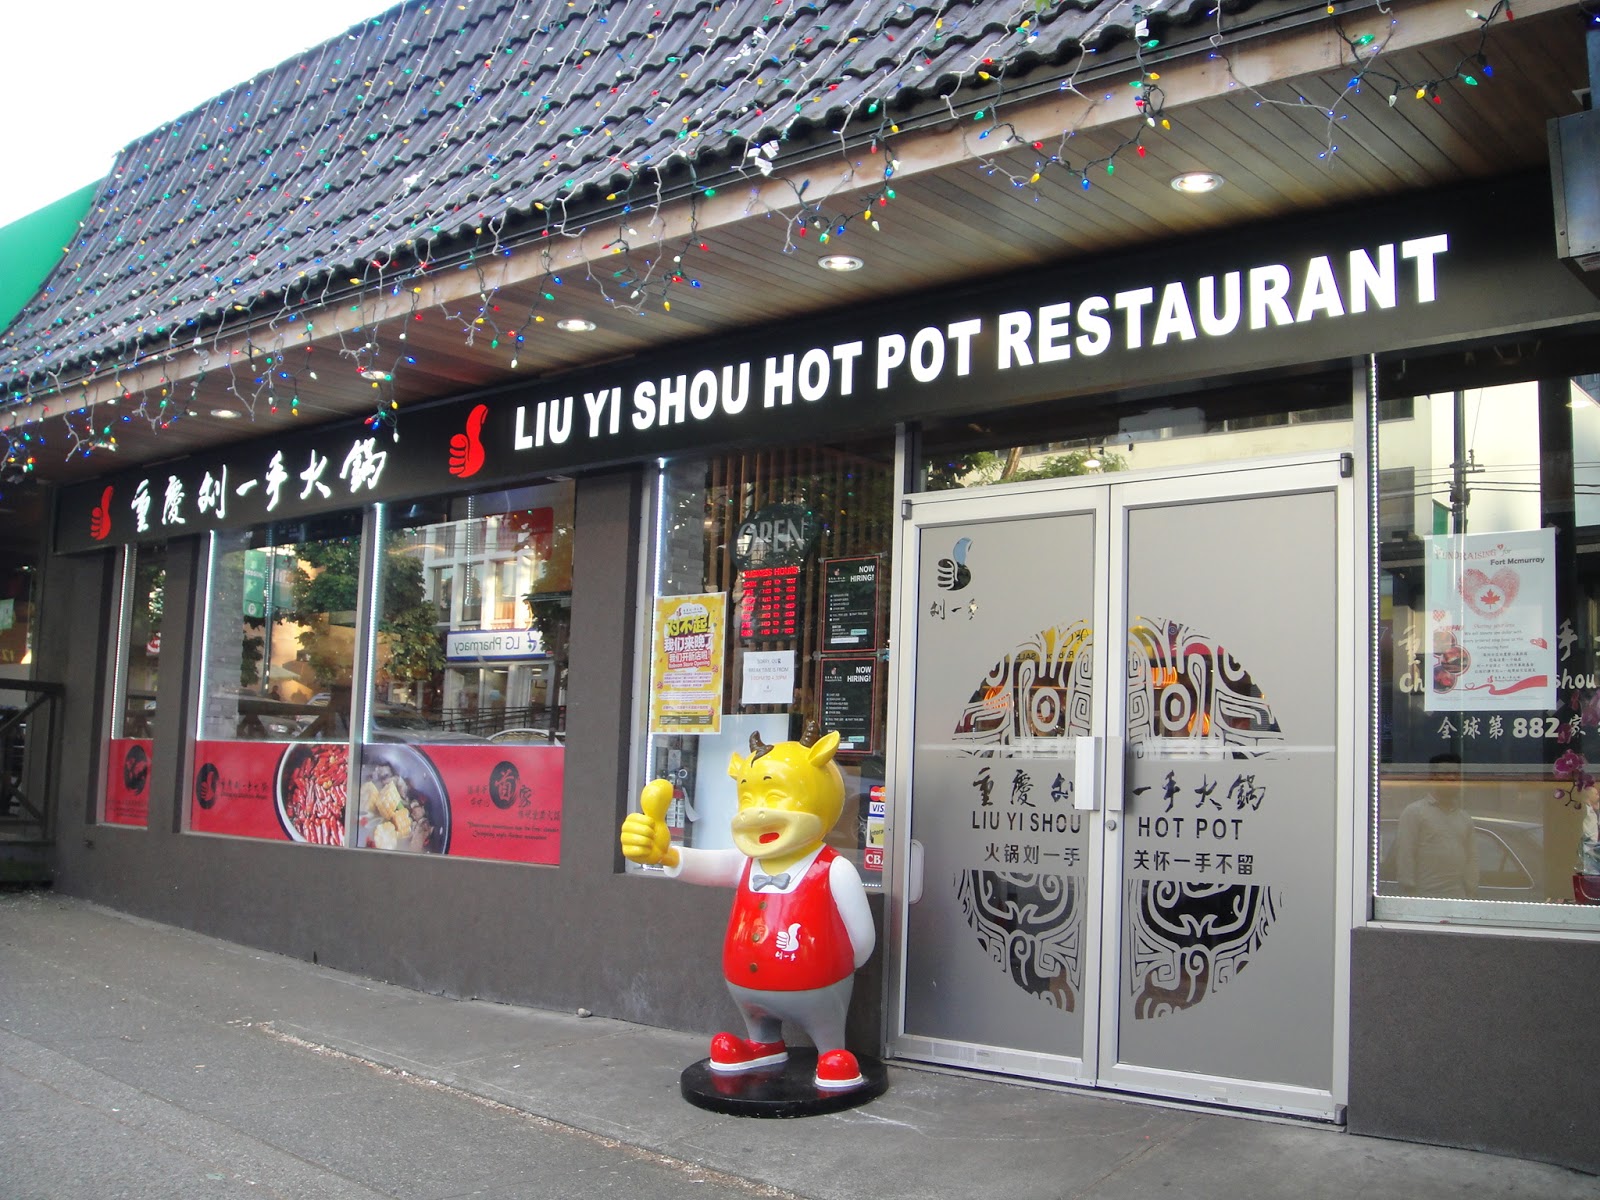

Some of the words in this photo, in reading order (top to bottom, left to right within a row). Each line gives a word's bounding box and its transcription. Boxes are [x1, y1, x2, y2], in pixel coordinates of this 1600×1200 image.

[515, 397, 574, 451] LIU
[584, 386, 622, 438] YI
[632, 361, 751, 430] SHOU
[764, 340, 863, 409] HOT
[877, 318, 982, 390] POT
[997, 233, 1448, 370] RESTAURANT
[736, 517, 806, 557] OPEN
[1435, 549, 1497, 561] FUNDRAISING
[1489, 558, 1506, 566] Fort
[1507, 556, 1545, 565] Mcmurray
[858, 565, 875, 573] NOW
[850, 574, 875, 582] HIRING!
[664, 634, 714, 653] 我们来晚了
[855, 665, 872, 673] NOW
[847, 675, 871, 683] HIRING!
[972, 810, 1000, 830] LIU
[1006, 811, 1023, 831] YI
[1029, 812, 1081, 834] SHOU
[1138, 816, 1185, 839] HOT
[1196, 818, 1243, 840] POT
[984, 842, 1080, 867] 火锅刘一手
[1133, 849, 1254, 876] 关怀一手不留
